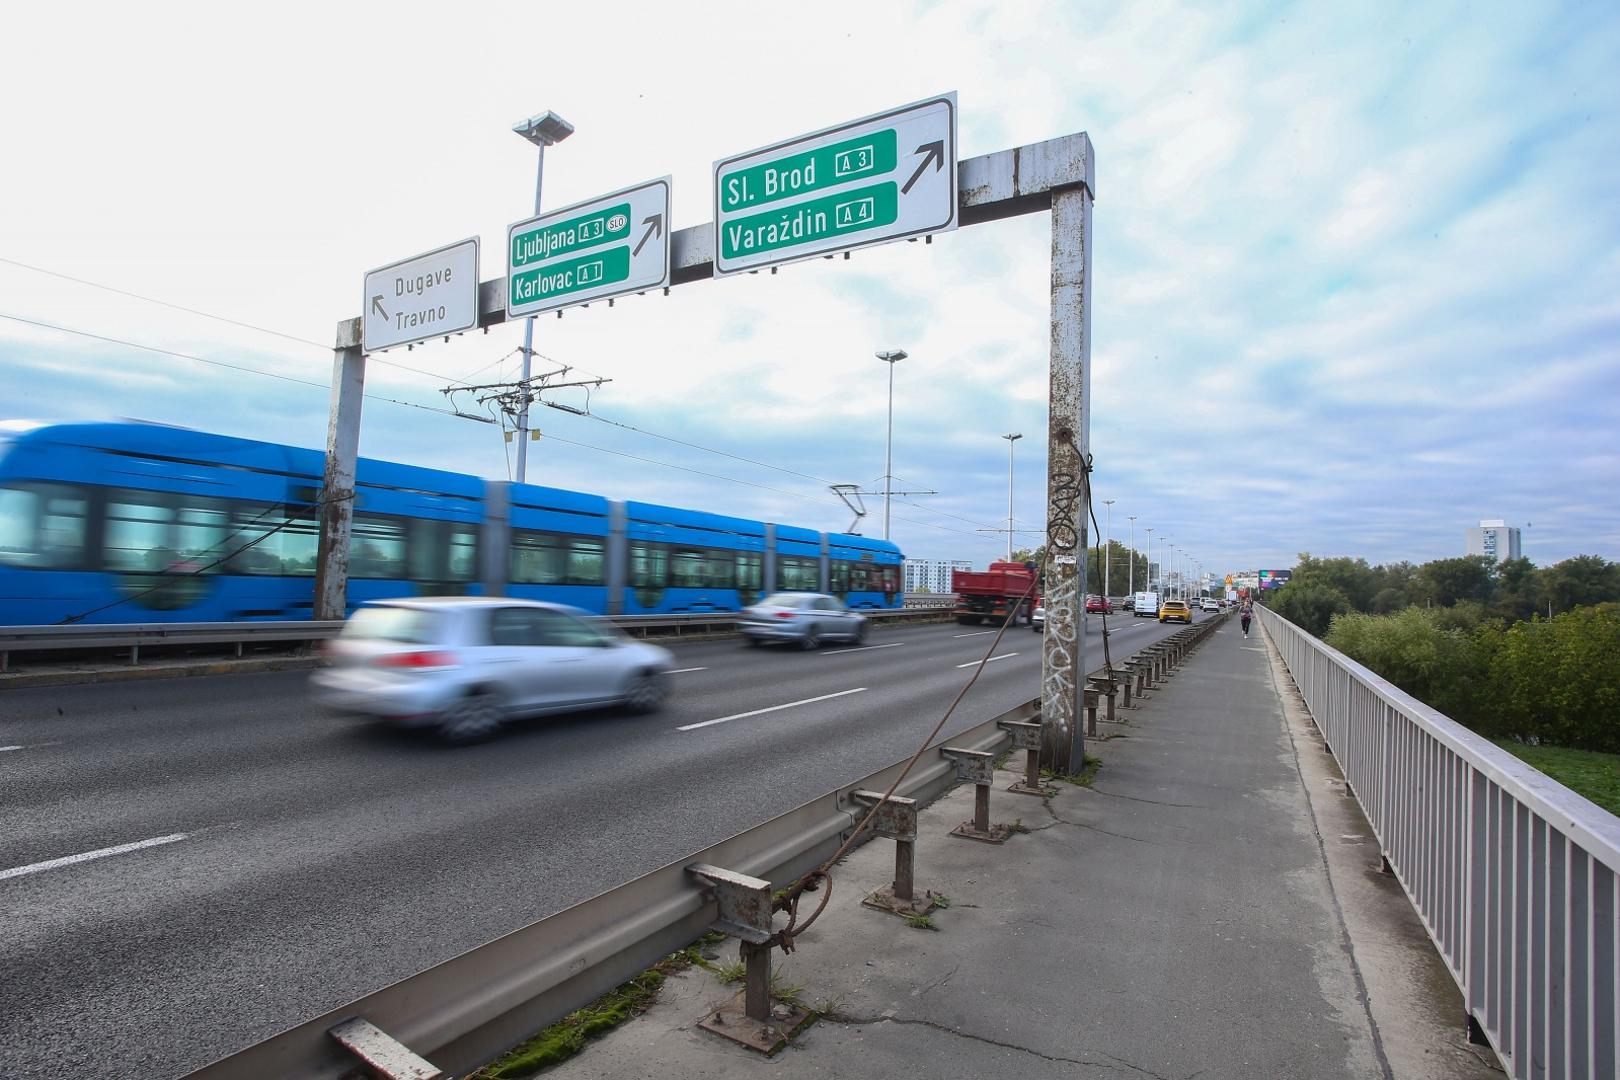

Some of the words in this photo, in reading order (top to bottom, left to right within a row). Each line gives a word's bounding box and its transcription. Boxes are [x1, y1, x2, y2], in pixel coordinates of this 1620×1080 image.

[728, 178, 755, 206] Sl.
[765, 157, 816, 197] Brod
[516, 228, 575, 264] Ljubljana
[609, 218, 625, 230] SLO
[729, 210, 826, 251] Varaždin
[395, 267, 452, 296] Dugave
[516, 269, 573, 299] Karlovac
[396, 305, 446, 331] Travno
